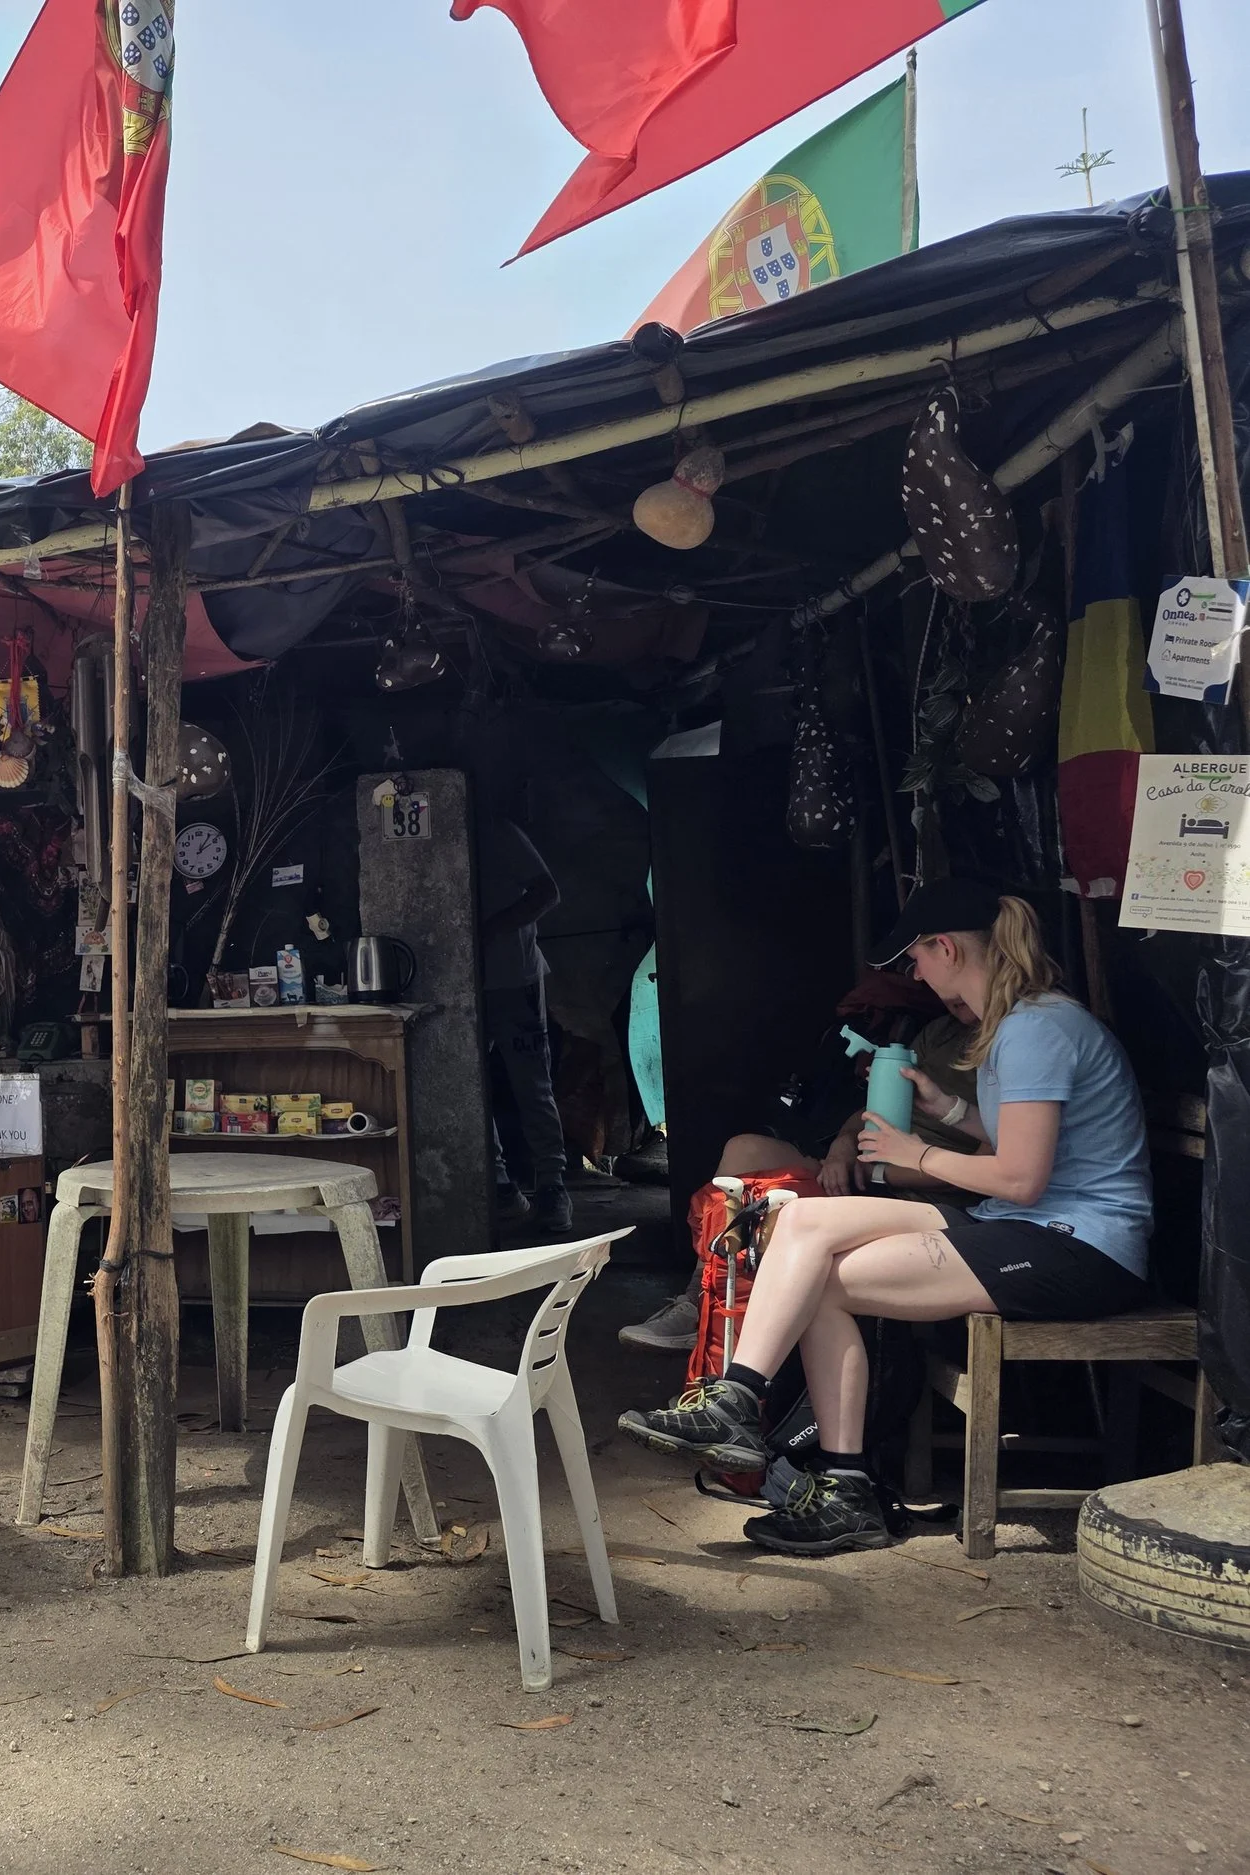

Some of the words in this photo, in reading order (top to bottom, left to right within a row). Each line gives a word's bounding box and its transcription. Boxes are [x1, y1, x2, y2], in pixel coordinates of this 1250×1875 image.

[1175, 636, 1198, 647] Private
[1171, 653, 1210, 665] Apartments
[1172, 763, 1248, 774] ALBERGUE
[1146, 786, 1184, 801] Casa
[1186, 779, 1206, 792] da
[9, 1130, 27, 1141] YOU
[999, 1261, 1033, 1273] benger
